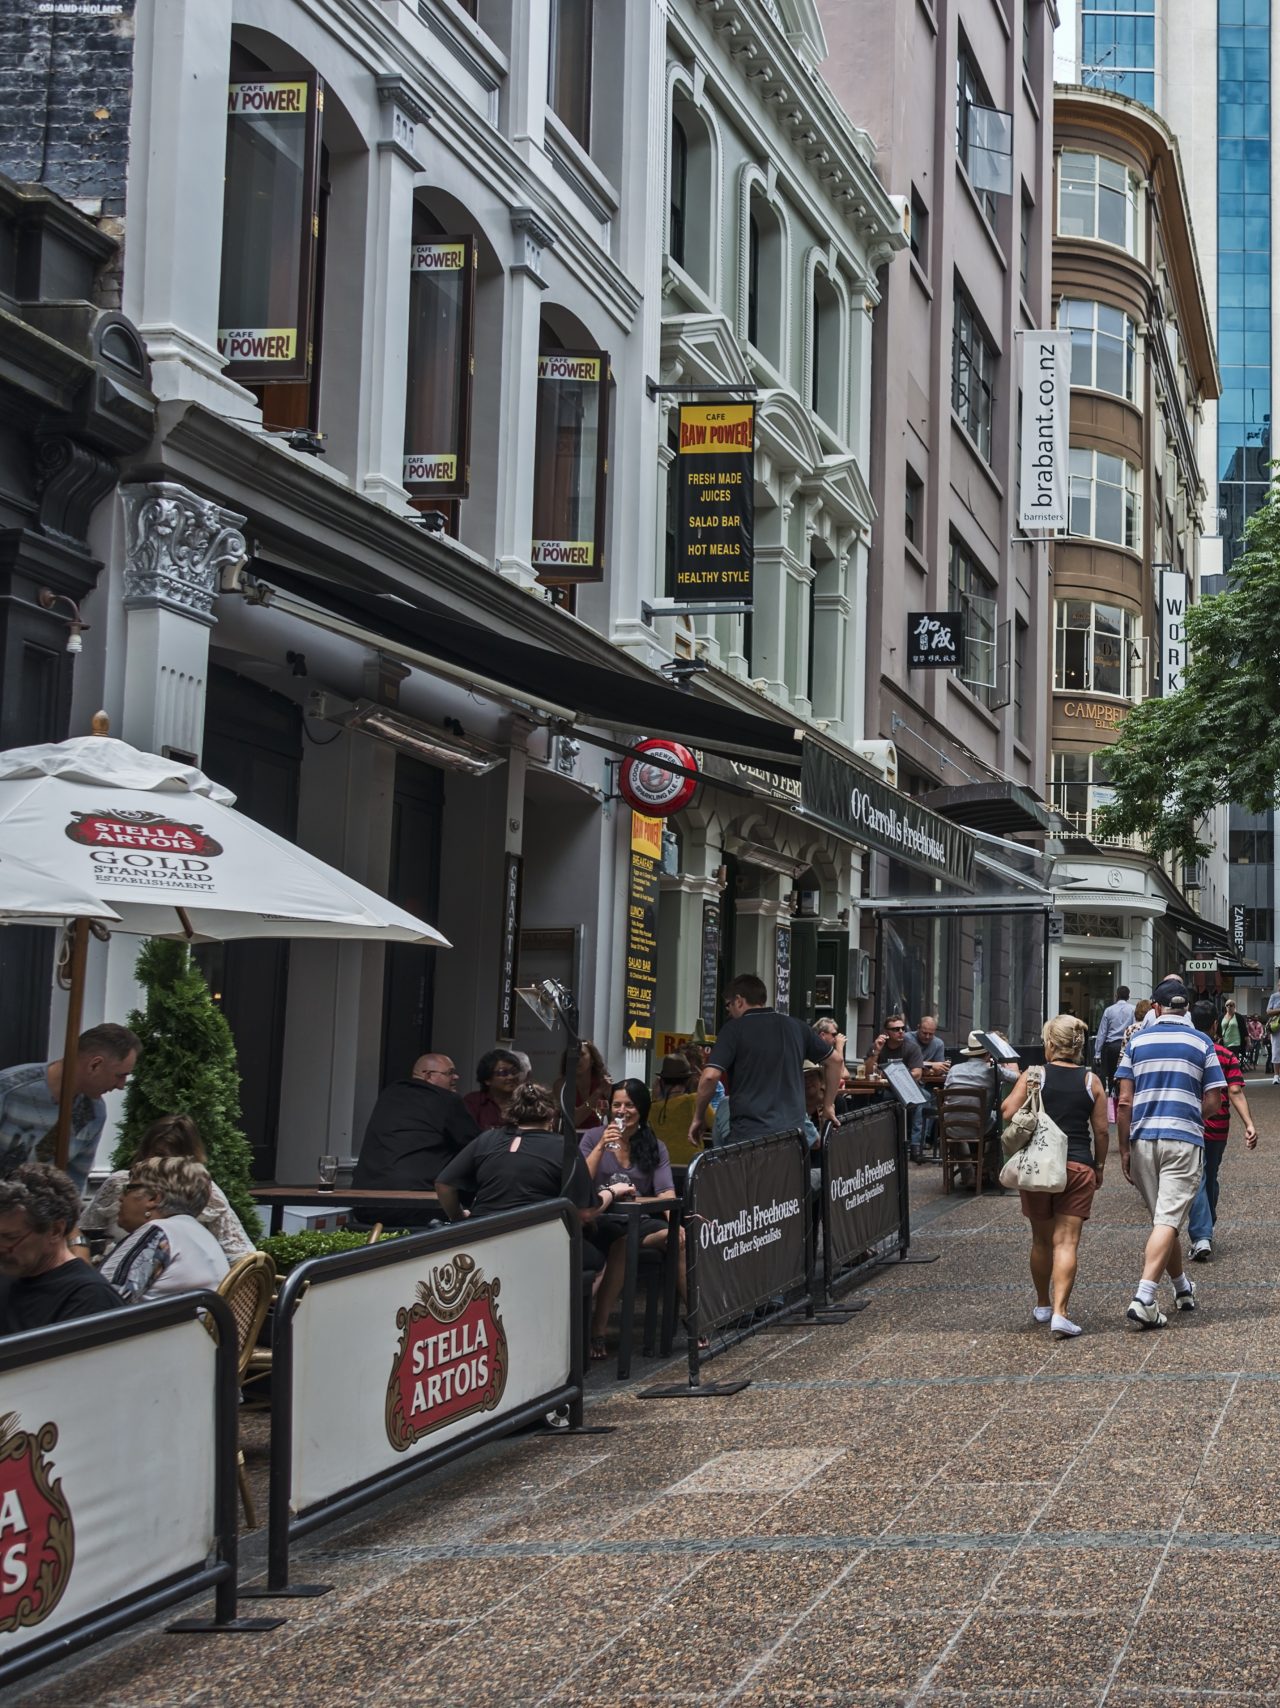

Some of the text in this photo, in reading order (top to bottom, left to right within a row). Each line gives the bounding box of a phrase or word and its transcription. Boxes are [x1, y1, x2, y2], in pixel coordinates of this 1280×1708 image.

[242, 89, 301, 112] POWER!
[417, 251, 462, 268] POWER!
[230, 335, 291, 359] POWER!
[551, 362, 596, 380] POWER!
[706, 413, 726, 421] CAFE
[1031, 344, 1056, 507] brabant.co.nz
[681, 417, 753, 449] RAW POWER!
[409, 461, 454, 479] POWER!
[688, 472, 742, 485] FRESH MADE
[700, 489, 731, 502] JUICES
[689, 515, 741, 528] SALAD BAR
[1024, 512, 1064, 521] barristers
[543, 546, 589, 564] POWER!
[688, 543, 740, 556] HOT MEALS
[678, 570, 750, 584] HEALTHY STYLE
[1064, 702, 1128, 722] CAMPBE
[635, 784, 678, 801] SPARKLING ALE
[851, 787, 902, 842] O'Carroll's
[94, 822, 192, 840] STELLA
[96, 833, 196, 850] ARTOIS
[89, 851, 209, 872] GOLD
[94, 865, 213, 882] STANDARD
[95, 874, 215, 890] ESTABLISHMENT
[503, 865, 518, 1029] CRAFT BEER
[831, 1169, 865, 1201] O'Carroll's
[845, 1183, 885, 1211] Craft Beer Specialists
[700, 1210, 752, 1250] O'Carroll's
[723, 1228, 781, 1261] Craft Beer Specialists
[412, 1318, 489, 1375] STELLA
[410, 1354, 489, 1417] ARTOIS
